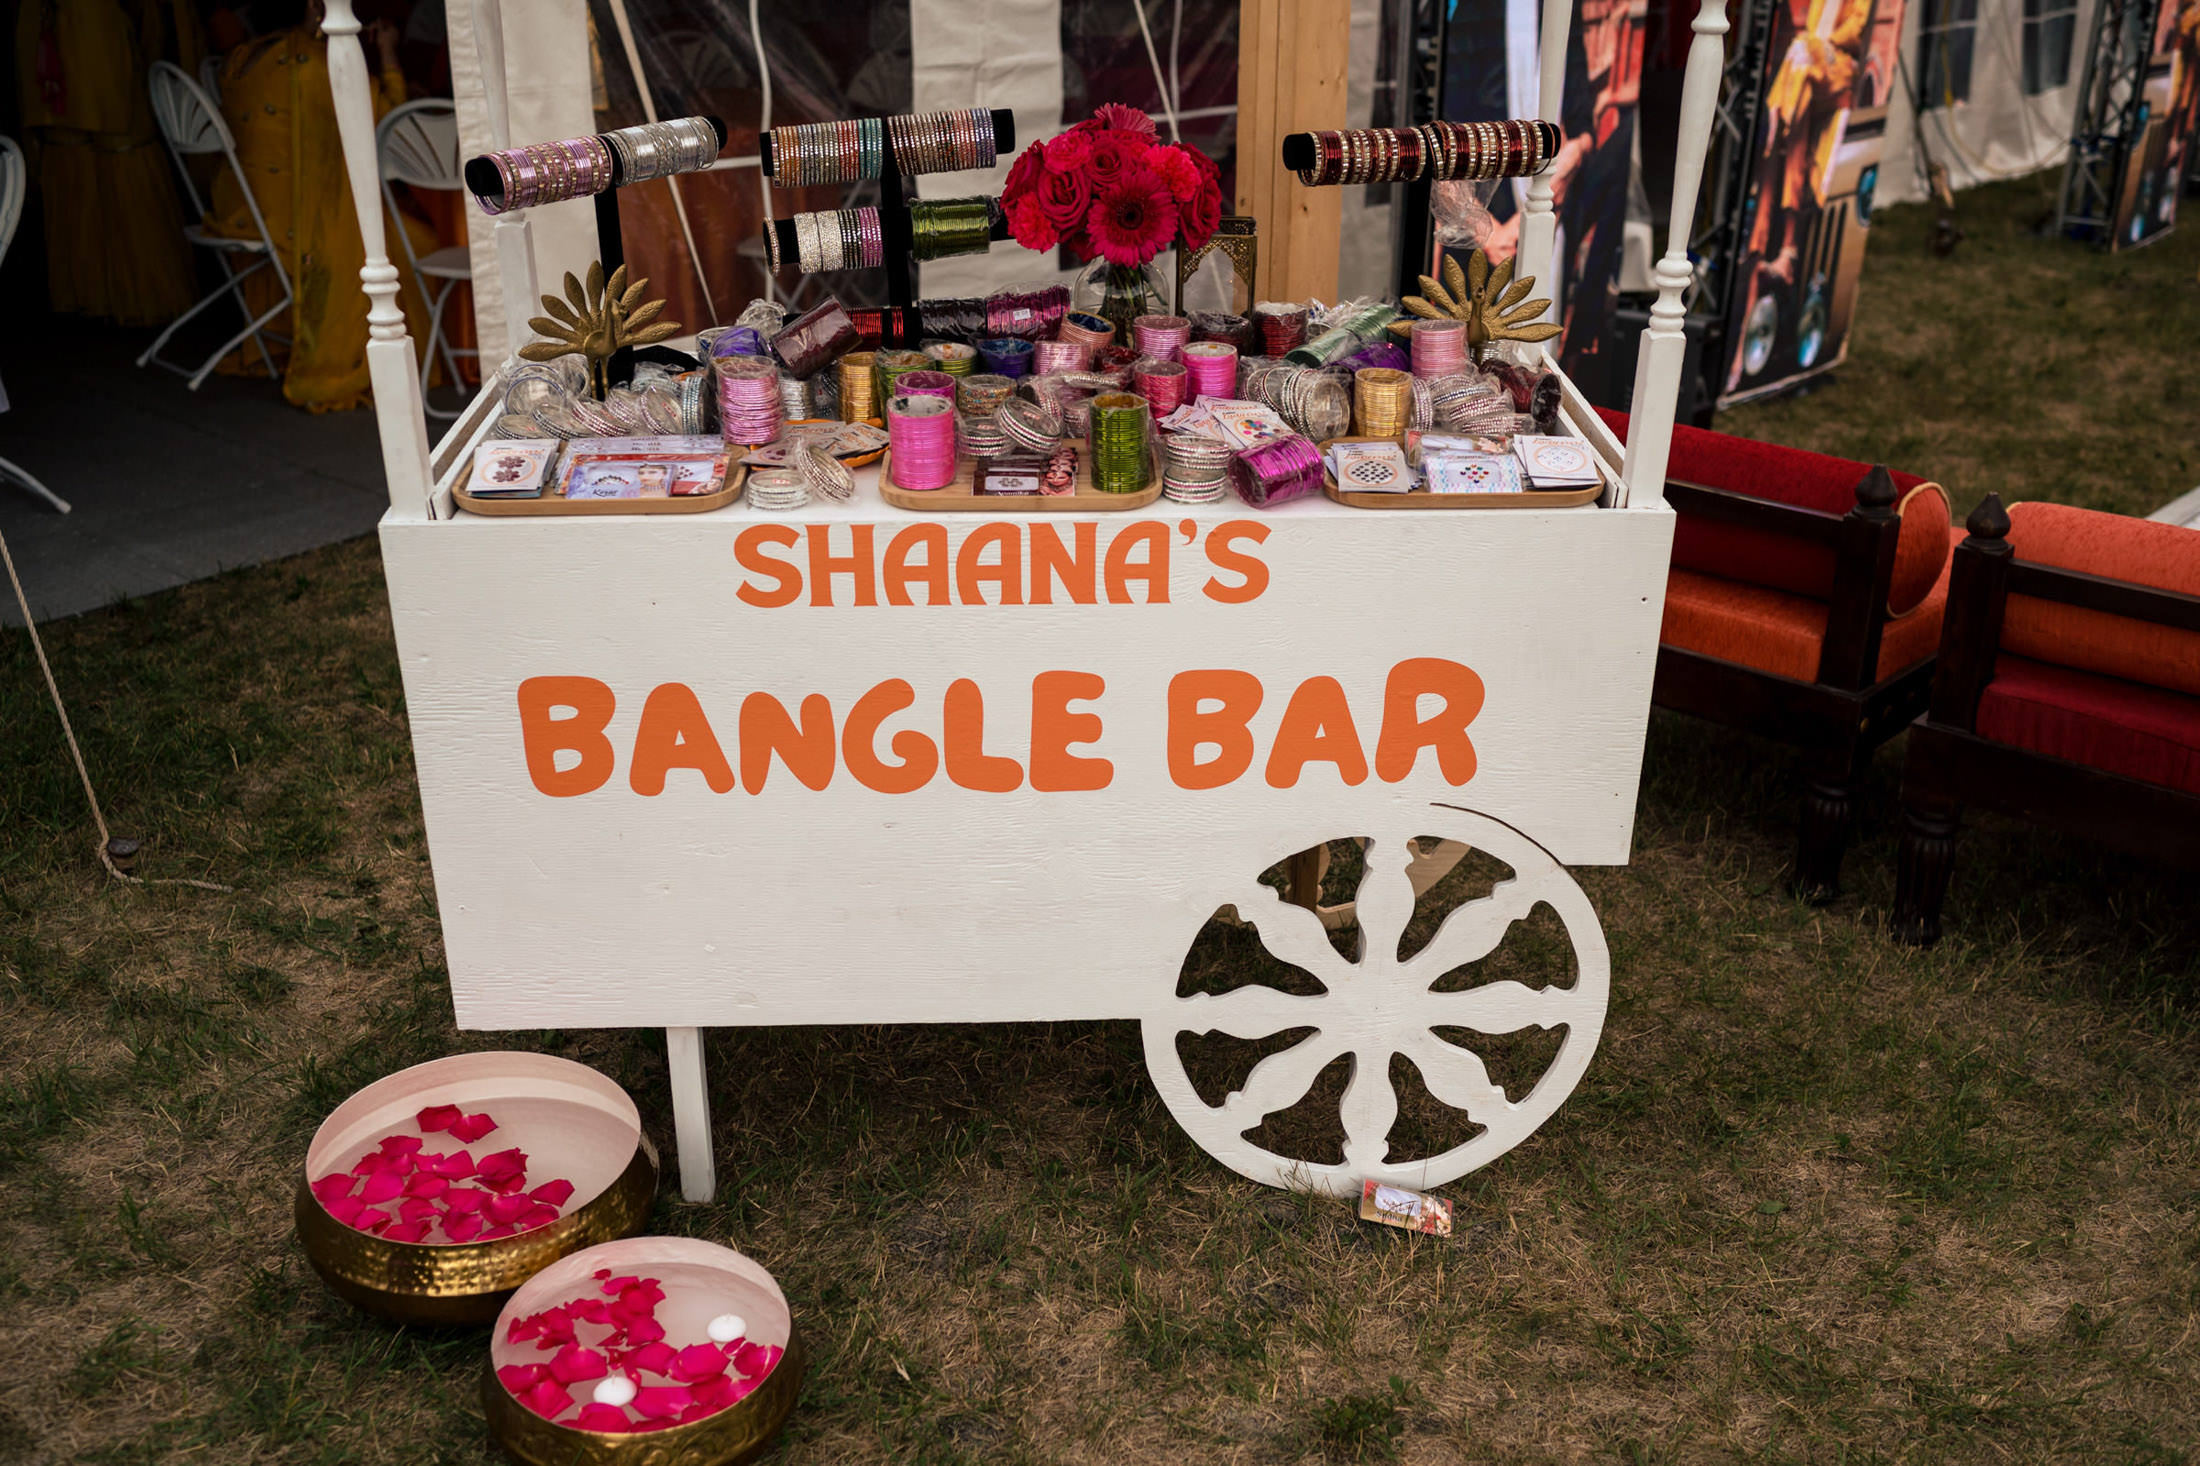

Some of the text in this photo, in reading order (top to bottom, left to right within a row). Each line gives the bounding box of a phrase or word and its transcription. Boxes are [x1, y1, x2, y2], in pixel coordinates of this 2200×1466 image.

[734, 518, 1272, 608] SHAANA'S
[517, 656, 1486, 798] BANGLE BAR
